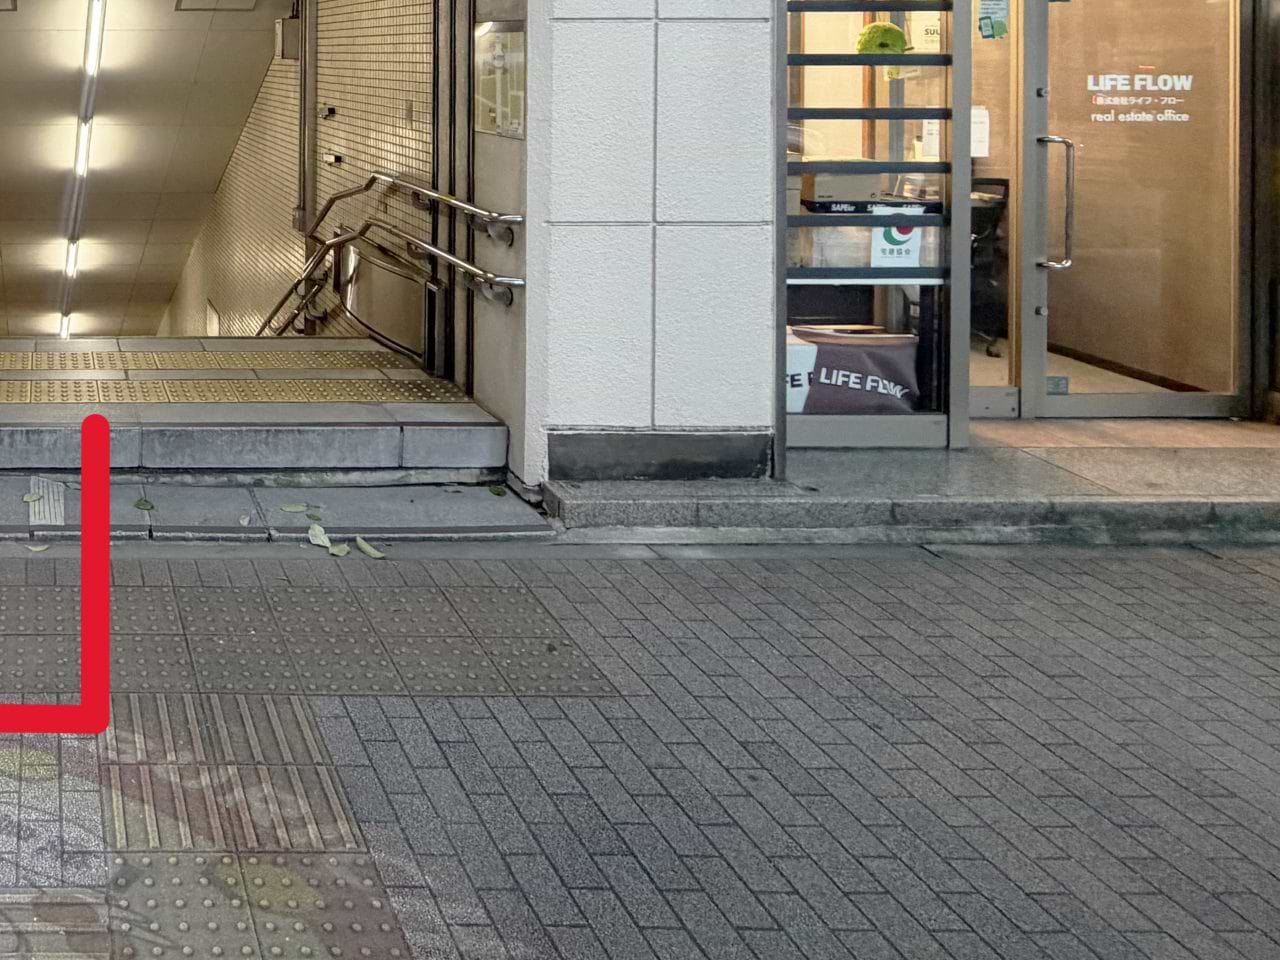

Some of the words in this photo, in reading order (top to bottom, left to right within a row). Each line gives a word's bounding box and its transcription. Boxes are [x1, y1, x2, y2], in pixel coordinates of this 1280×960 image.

[1087, 74, 1131, 91] LIFE
[1134, 74, 1193, 91] FLOW
[1091, 109, 1115, 121] real
[1118, 111, 1154, 121] estate
[1156, 109, 1190, 121] office
[820, 367, 862, 390] LIFE
